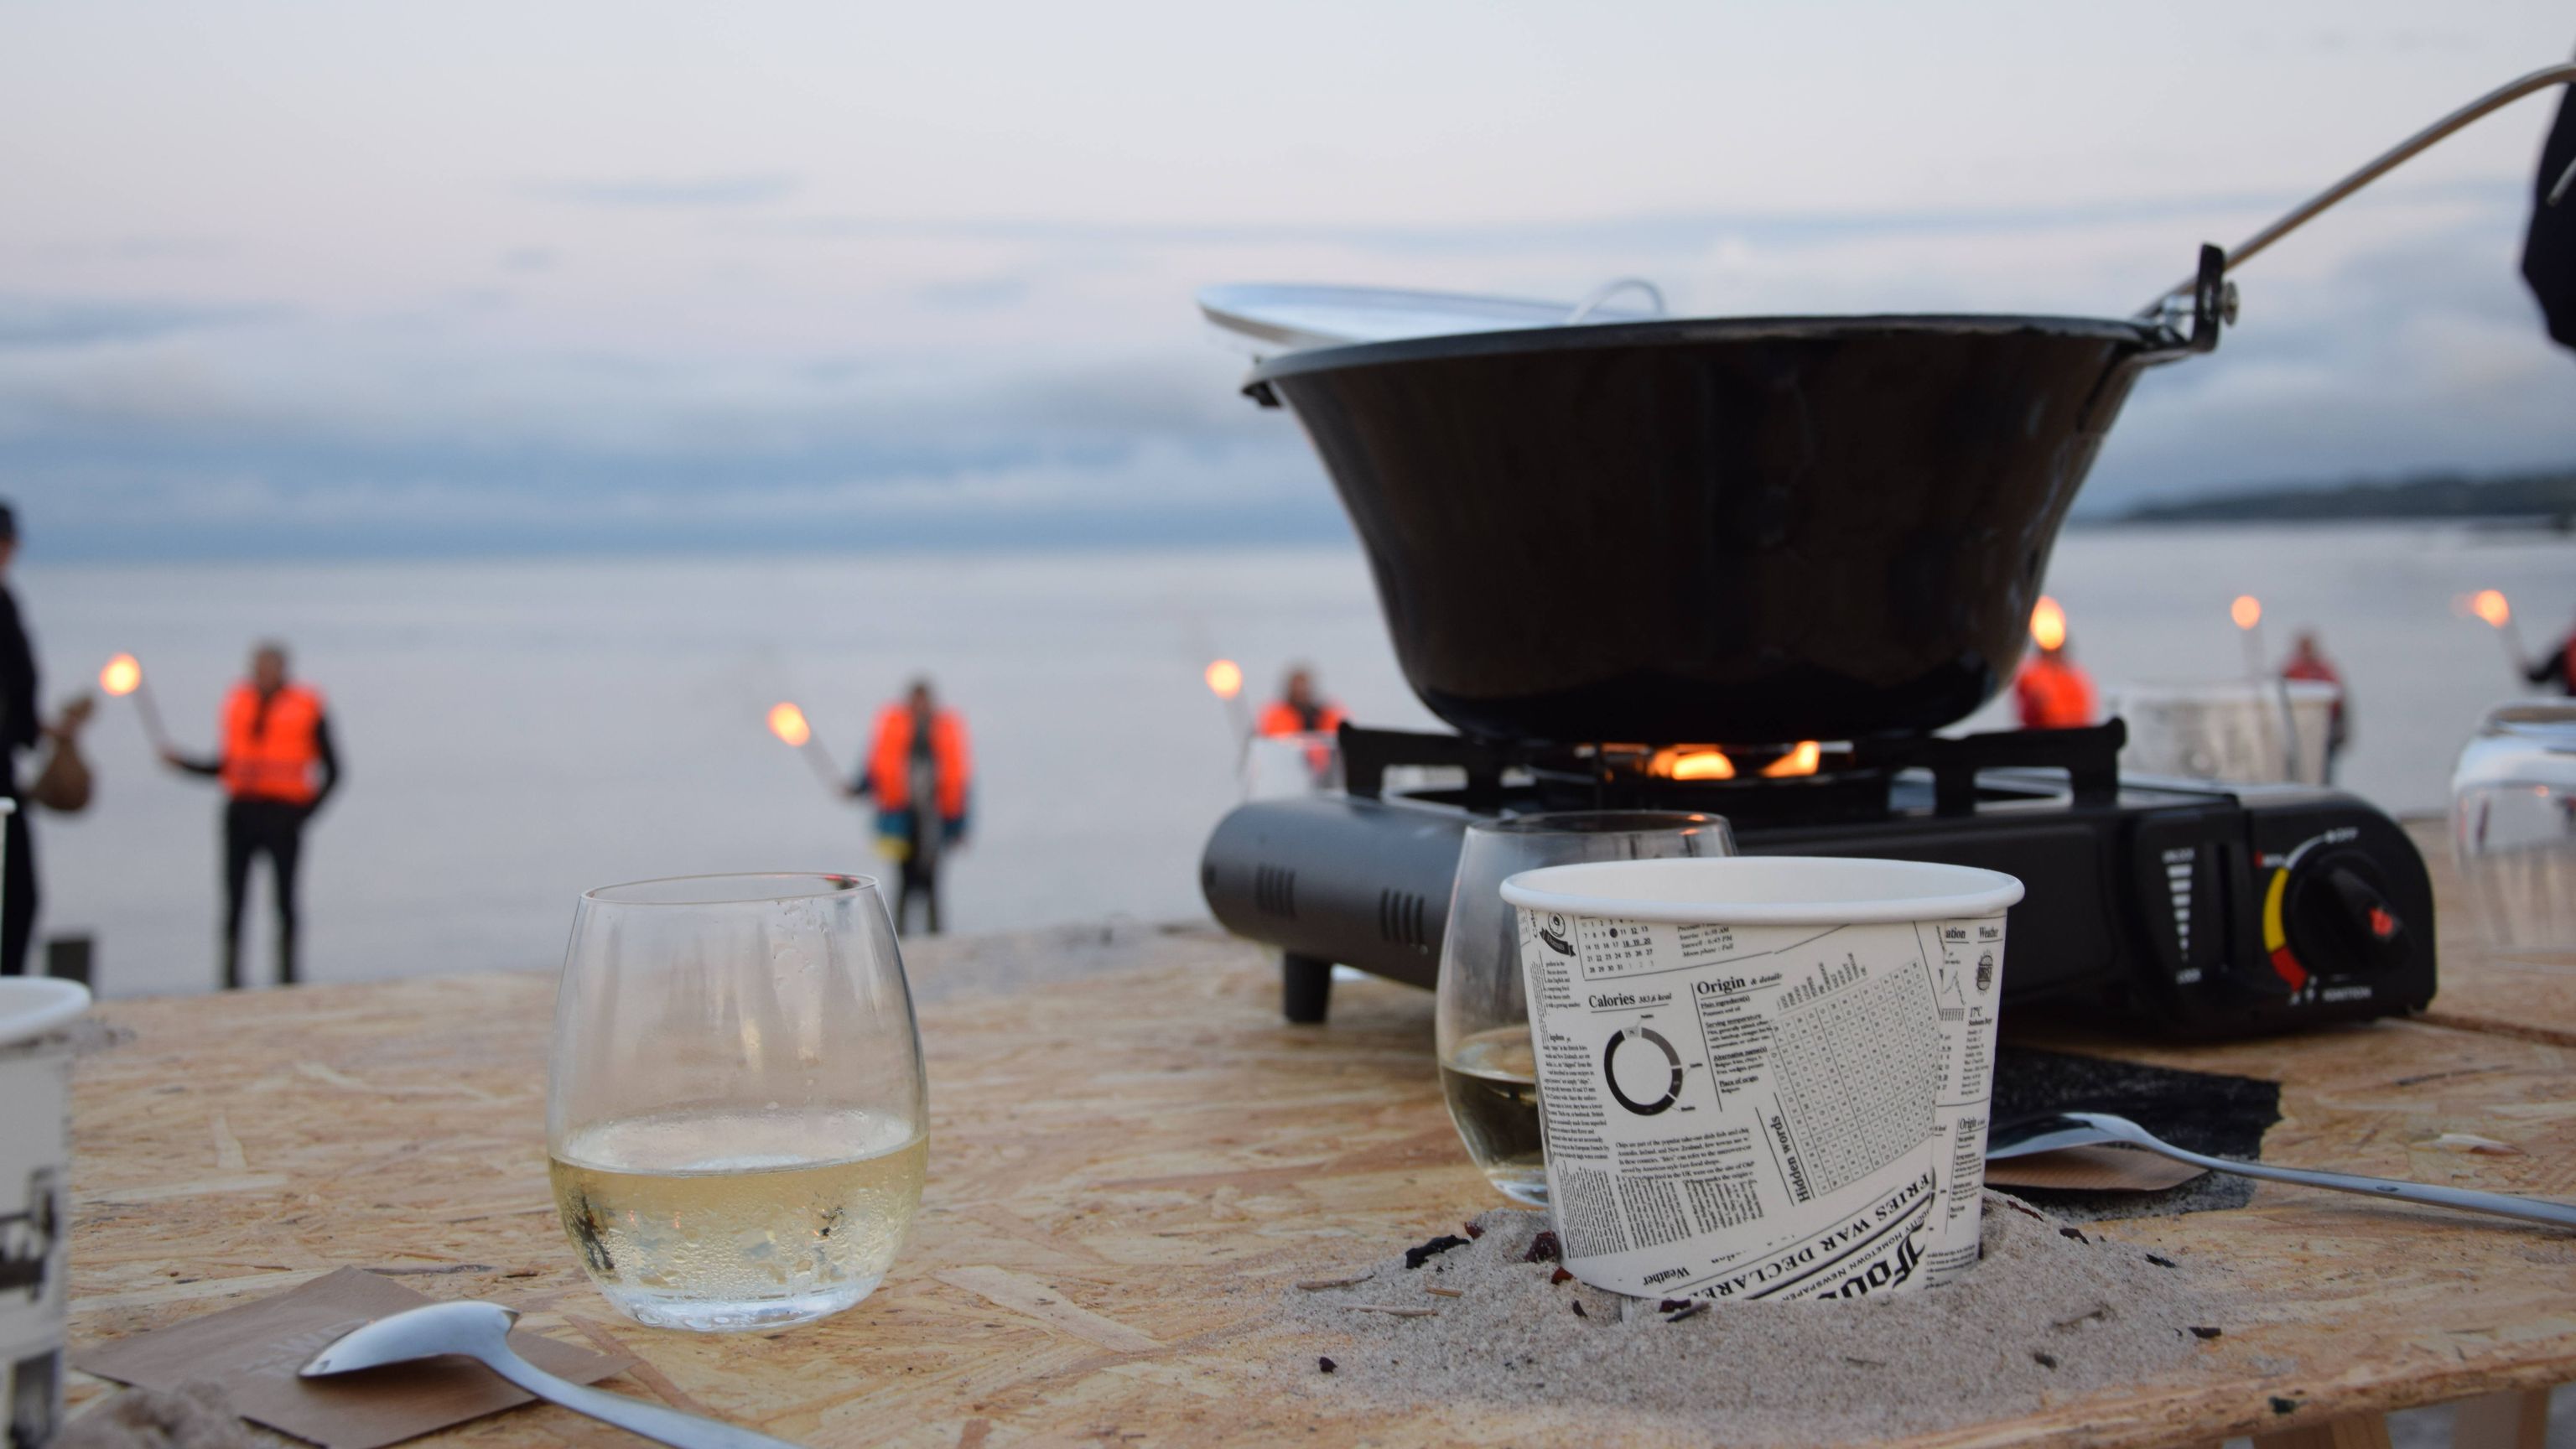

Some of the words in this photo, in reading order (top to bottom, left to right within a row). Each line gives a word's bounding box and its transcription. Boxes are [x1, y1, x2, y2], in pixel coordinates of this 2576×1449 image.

[1589, 993, 1635, 1009] Calories
[1696, 976, 1746, 995] Origin
[1770, 1115, 1791, 1154] words
[1787, 1156, 1810, 1202] Hidden
[1875, 1172, 1929, 1222] FRIES
[1819, 1218, 1872, 1252] WAR
[1849, 1233, 1903, 1270] HOMETOWN
[1644, 1266, 1690, 1285] Weather
[1689, 1247, 1816, 1299] DECLARE
